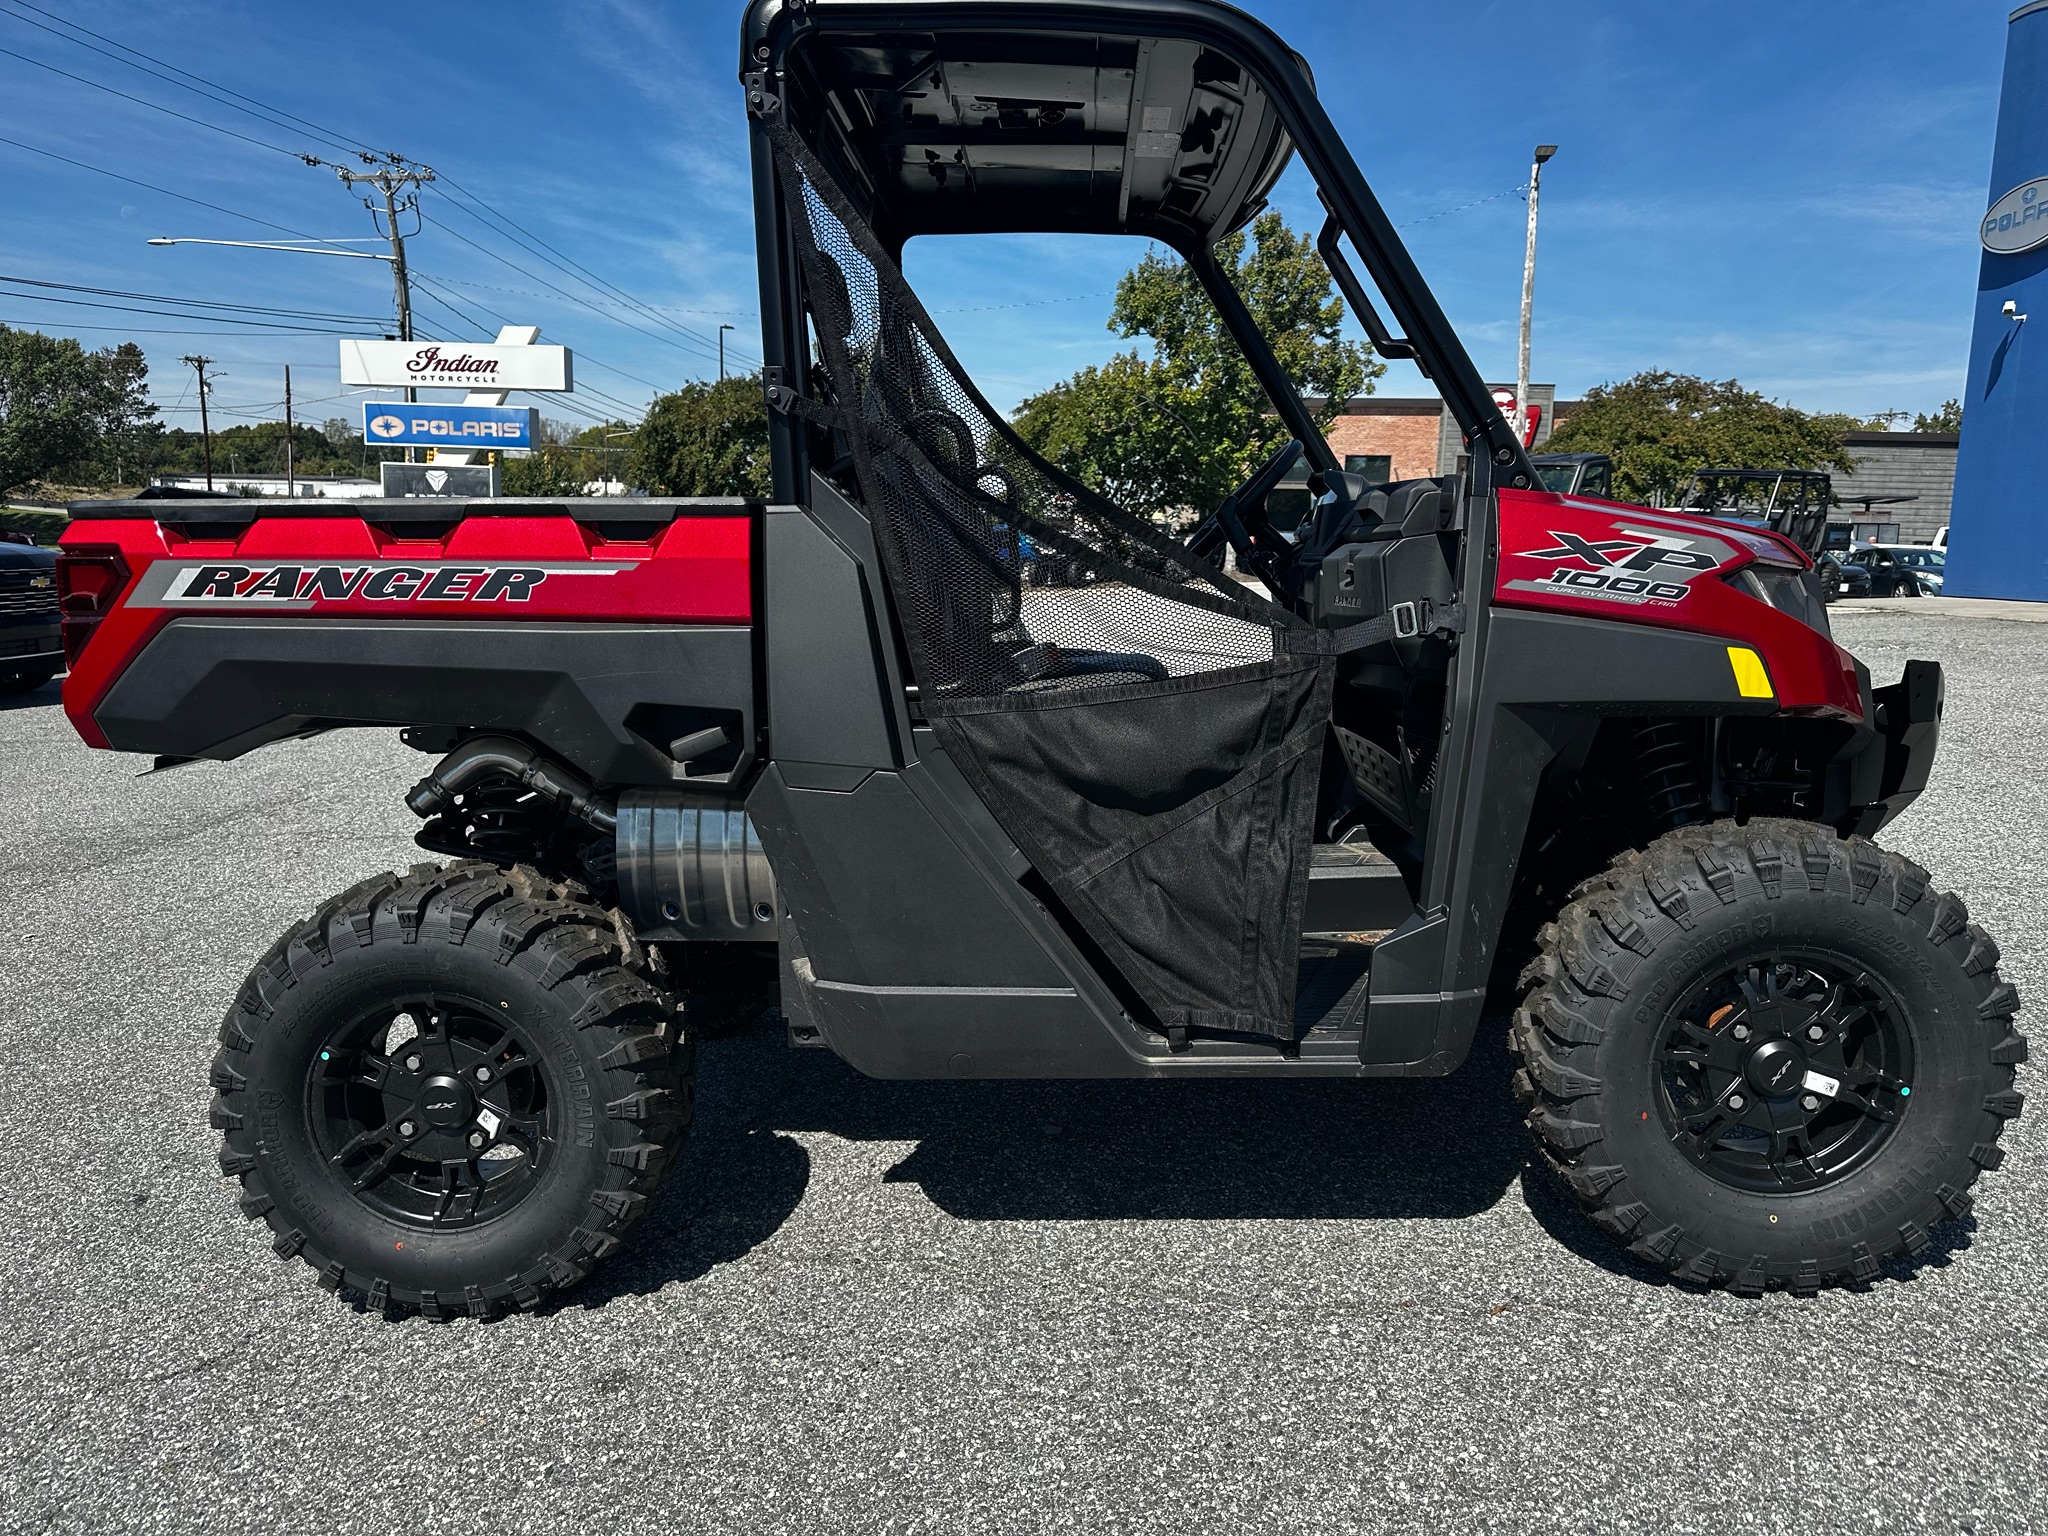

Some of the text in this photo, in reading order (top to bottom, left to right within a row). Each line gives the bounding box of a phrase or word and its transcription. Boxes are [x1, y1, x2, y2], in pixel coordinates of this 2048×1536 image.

[406, 347, 499, 373] Indian
[410, 375, 496, 383] MOTORCYCLE
[411, 419, 522, 438] POLARIS
[1511, 530, 1721, 572] XP
[181, 565, 547, 602] RANGER
[1545, 586, 1678, 608] DUAL OVERHEAD CAM
[1550, 567, 1691, 601] 1000
[1333, 595, 1361, 608] RANGER
[1634, 922, 1748, 1025] PRO ARMOR
[522, 1001, 595, 1149] X-TERRAIN
[1770, 1059, 1794, 1087] XP
[1811, 1136, 1953, 1242] X-TERRAIN
